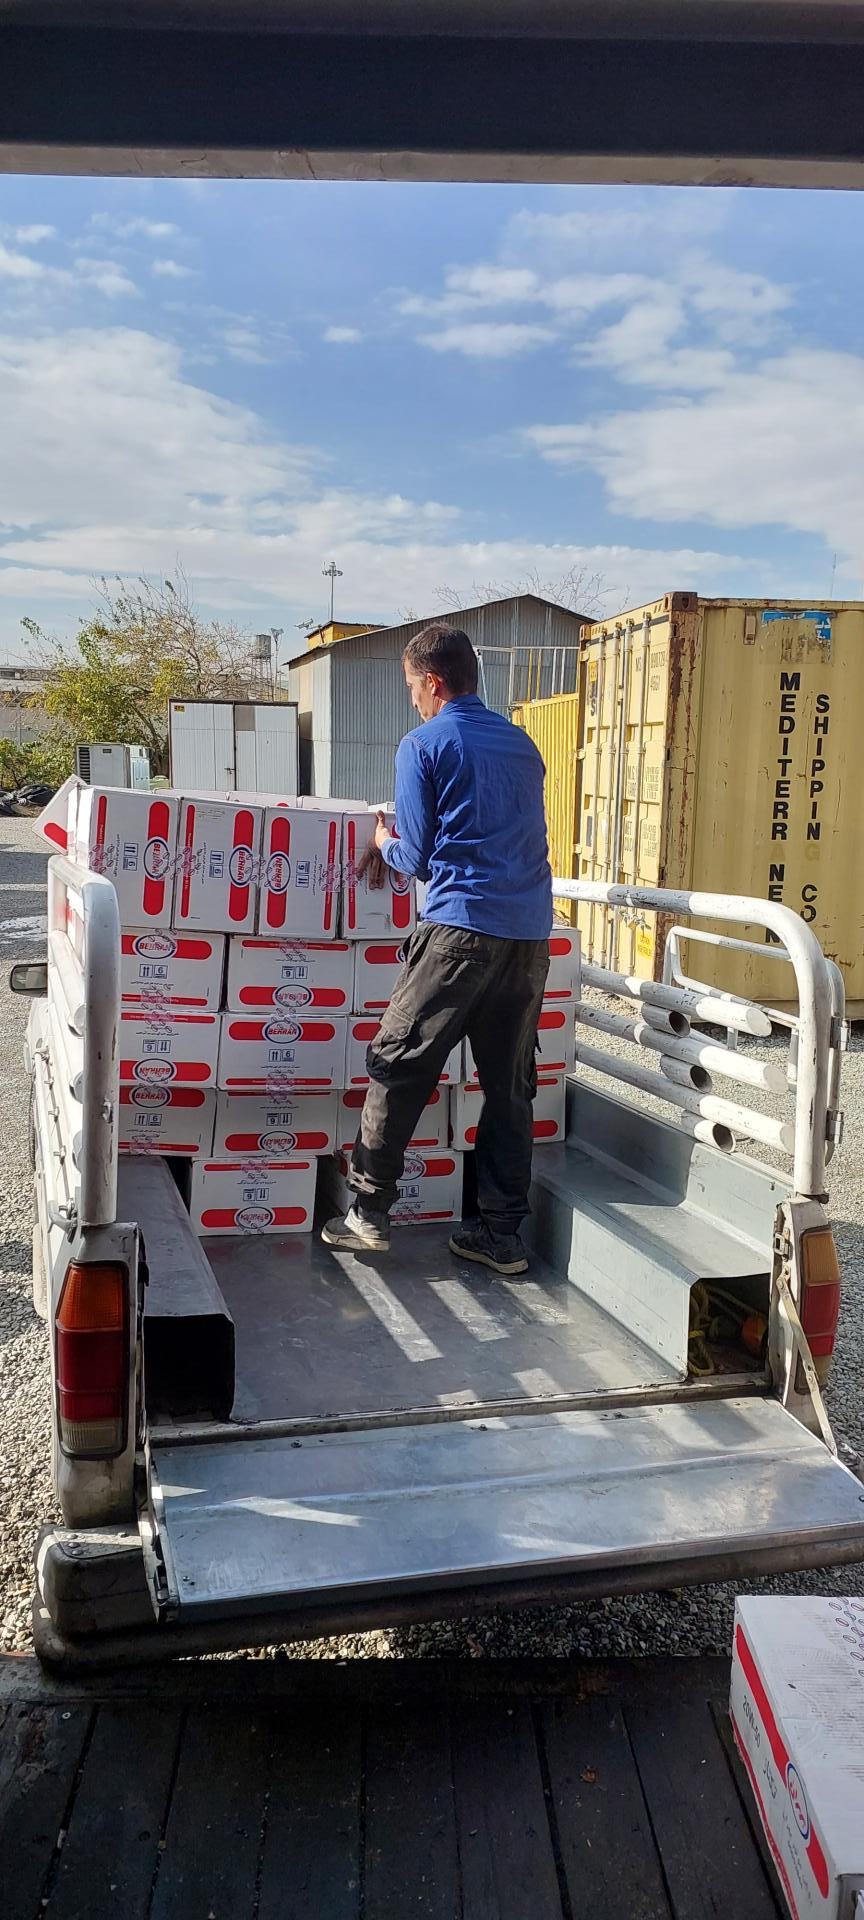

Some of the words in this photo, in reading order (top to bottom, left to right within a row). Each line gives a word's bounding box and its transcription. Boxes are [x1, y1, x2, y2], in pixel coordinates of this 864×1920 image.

[805, 694, 830, 861] SHIPPING
[765, 672, 801, 943] MEDITERRANEN
[236, 850, 246, 882] BEHRAN
[274, 857, 283, 888] BEHRAN
[801, 884, 818, 923] CO
[139, 1067, 171, 1075] BEHRAN
[135, 1092, 166, 1101] BEHRAN
